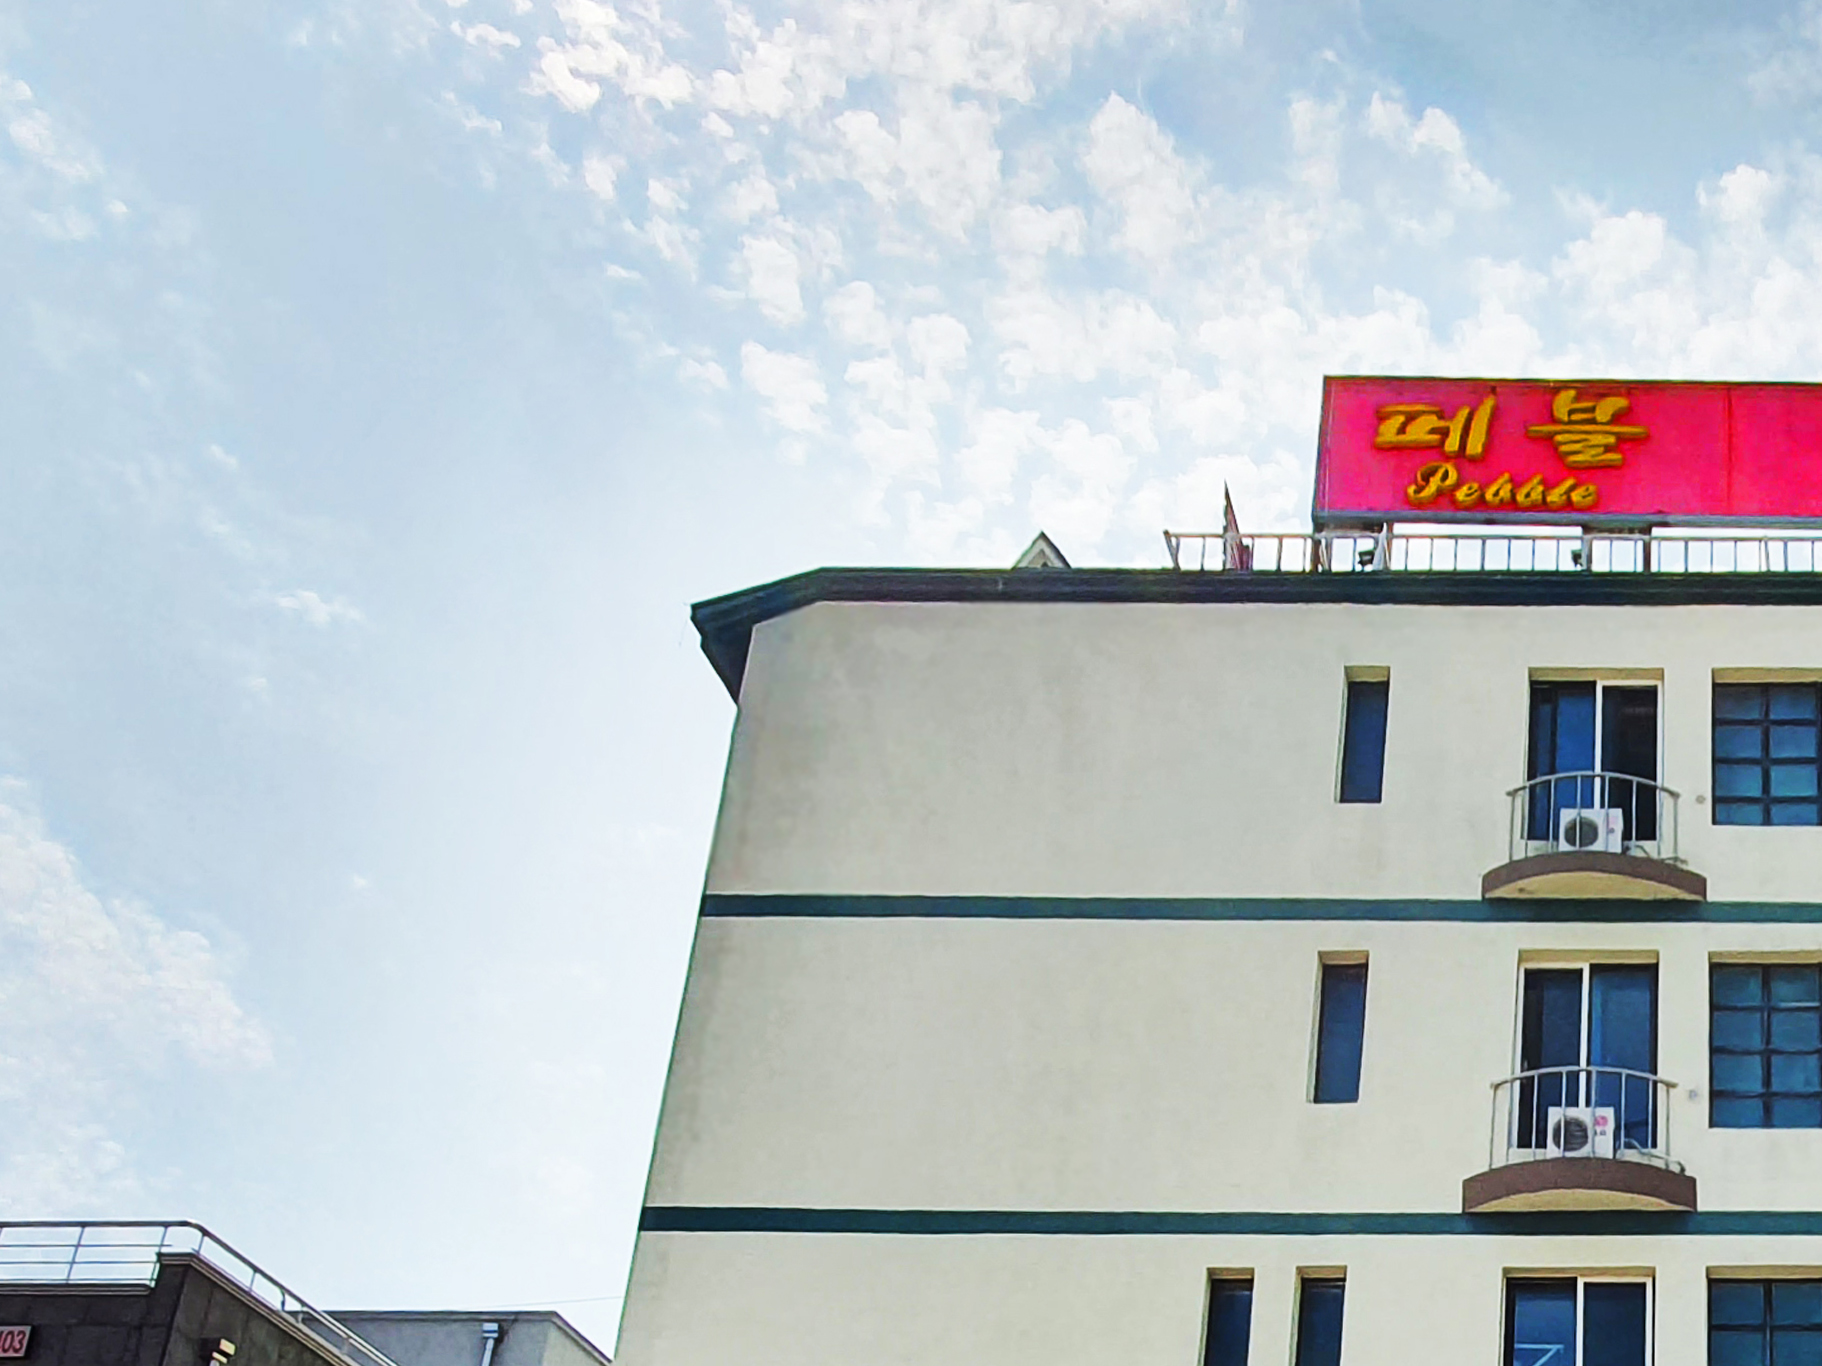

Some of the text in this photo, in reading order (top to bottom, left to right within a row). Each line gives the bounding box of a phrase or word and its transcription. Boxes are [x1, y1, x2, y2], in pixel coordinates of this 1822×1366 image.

[1374, 388, 1650, 468] 페블
[1406, 461, 1600, 510] Pebble
[0, 1329, 26, 1353] 03
